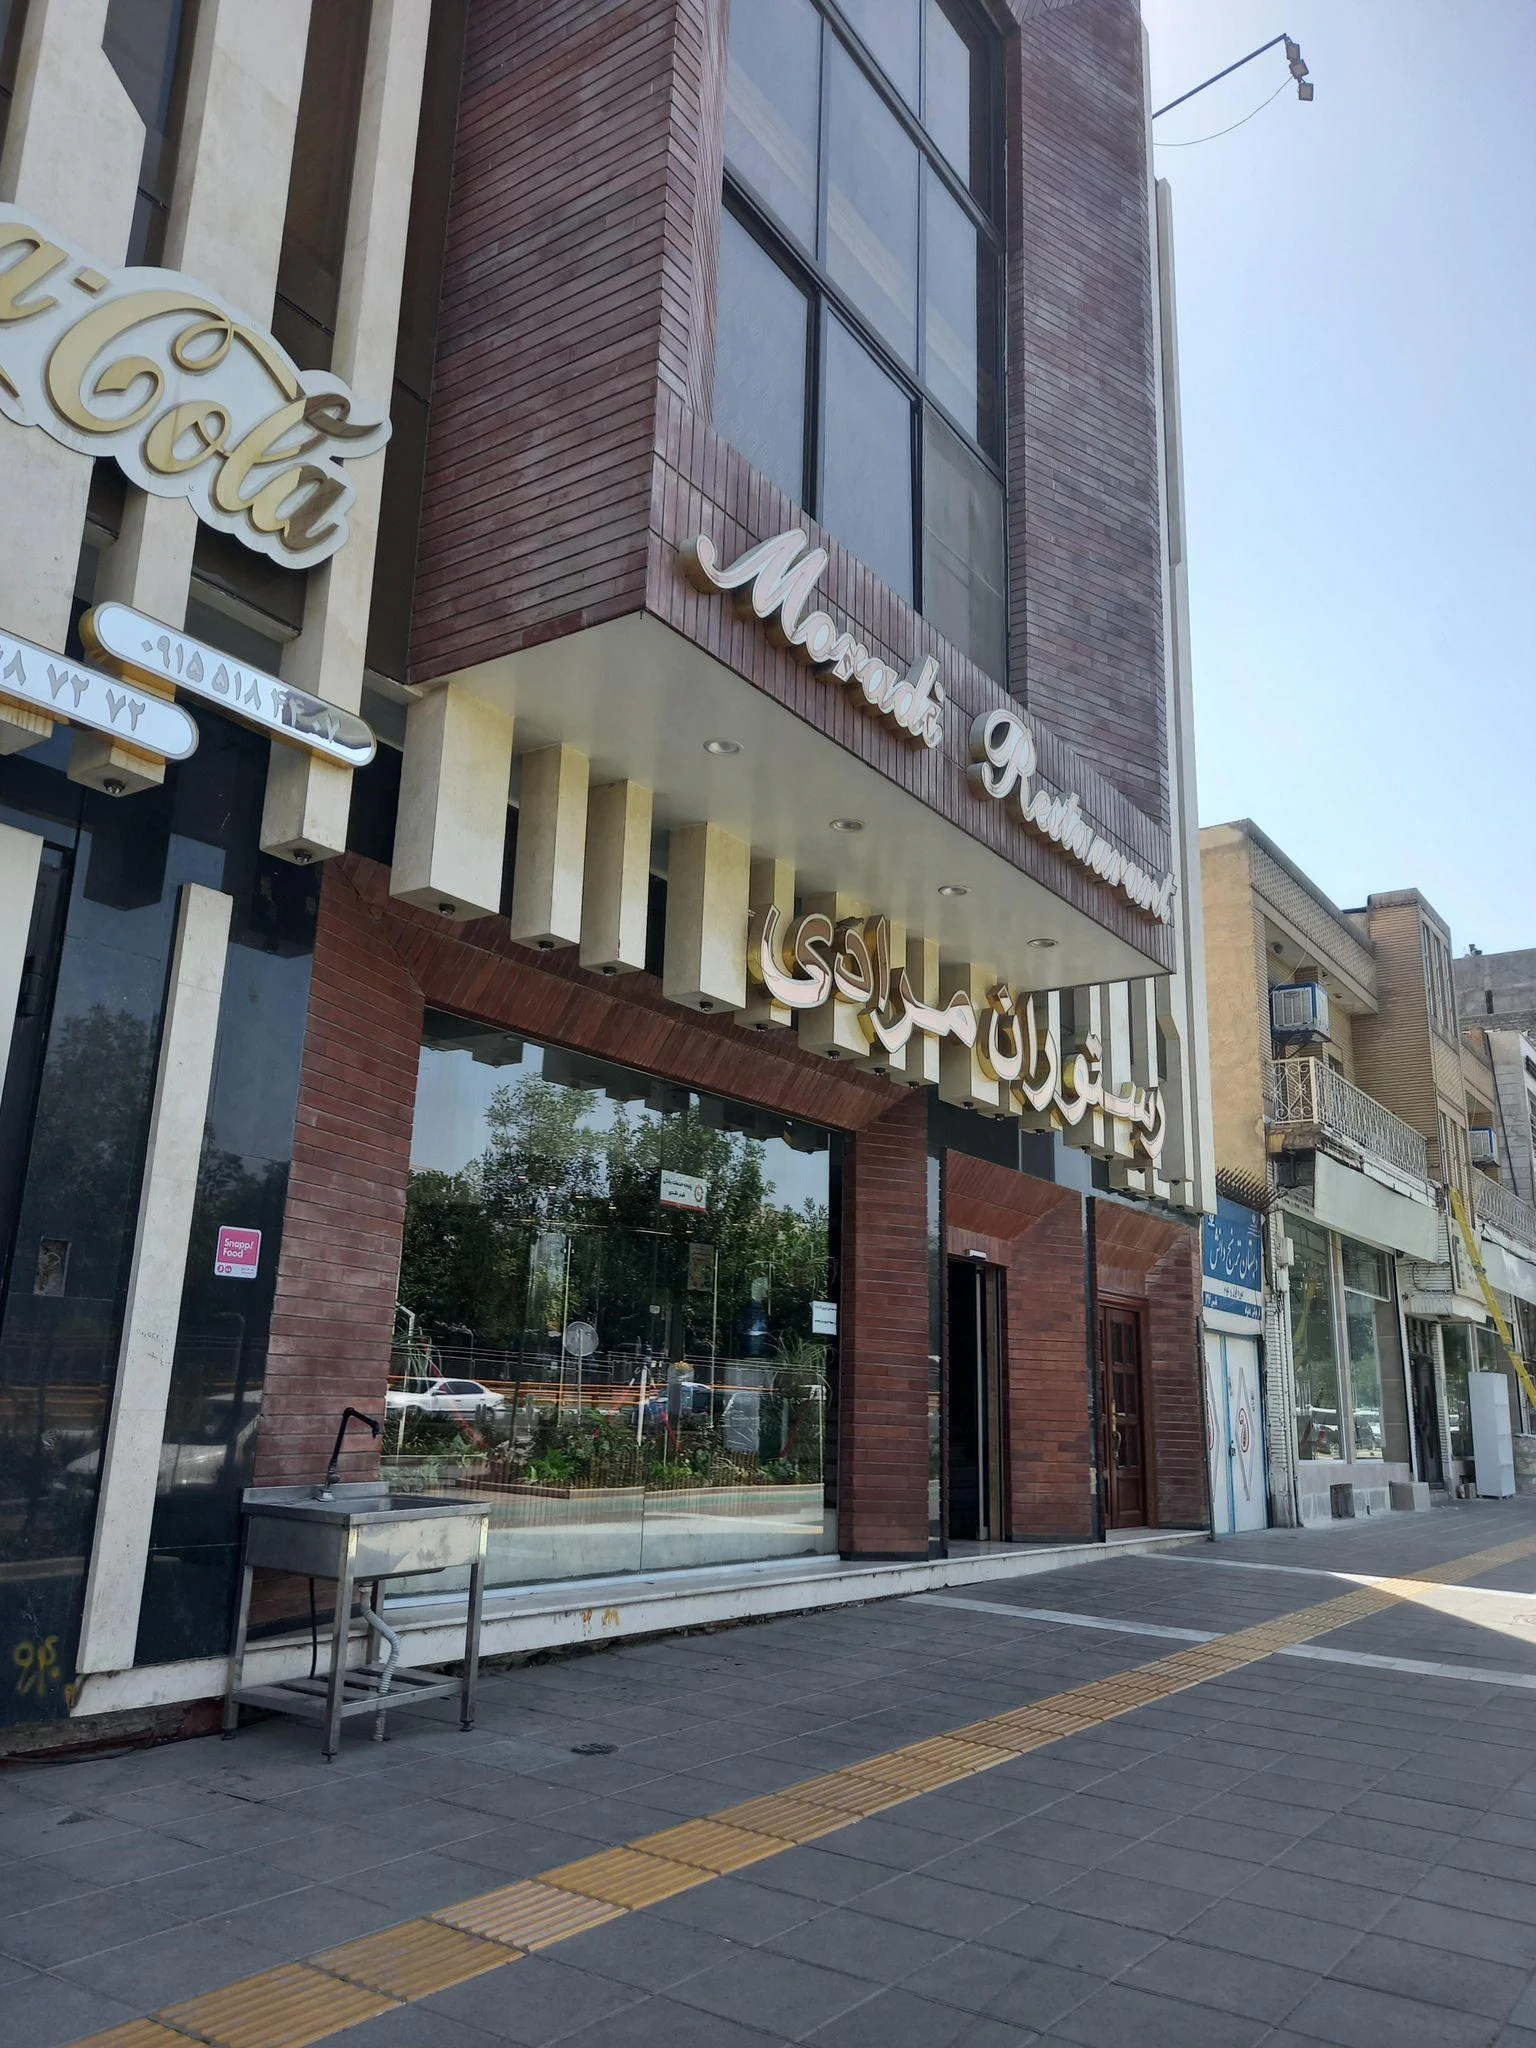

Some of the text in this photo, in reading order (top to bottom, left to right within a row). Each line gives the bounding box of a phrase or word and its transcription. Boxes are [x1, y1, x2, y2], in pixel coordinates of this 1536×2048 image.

[0, 645, 28, 686] ۸
[760, 903, 1167, 1160] رستوران مرادی
[222, 1247, 244, 1258] Food
[223, 1237, 255, 1251] Snapp!
[1239, 1239, 1258, 1279] دبستان
